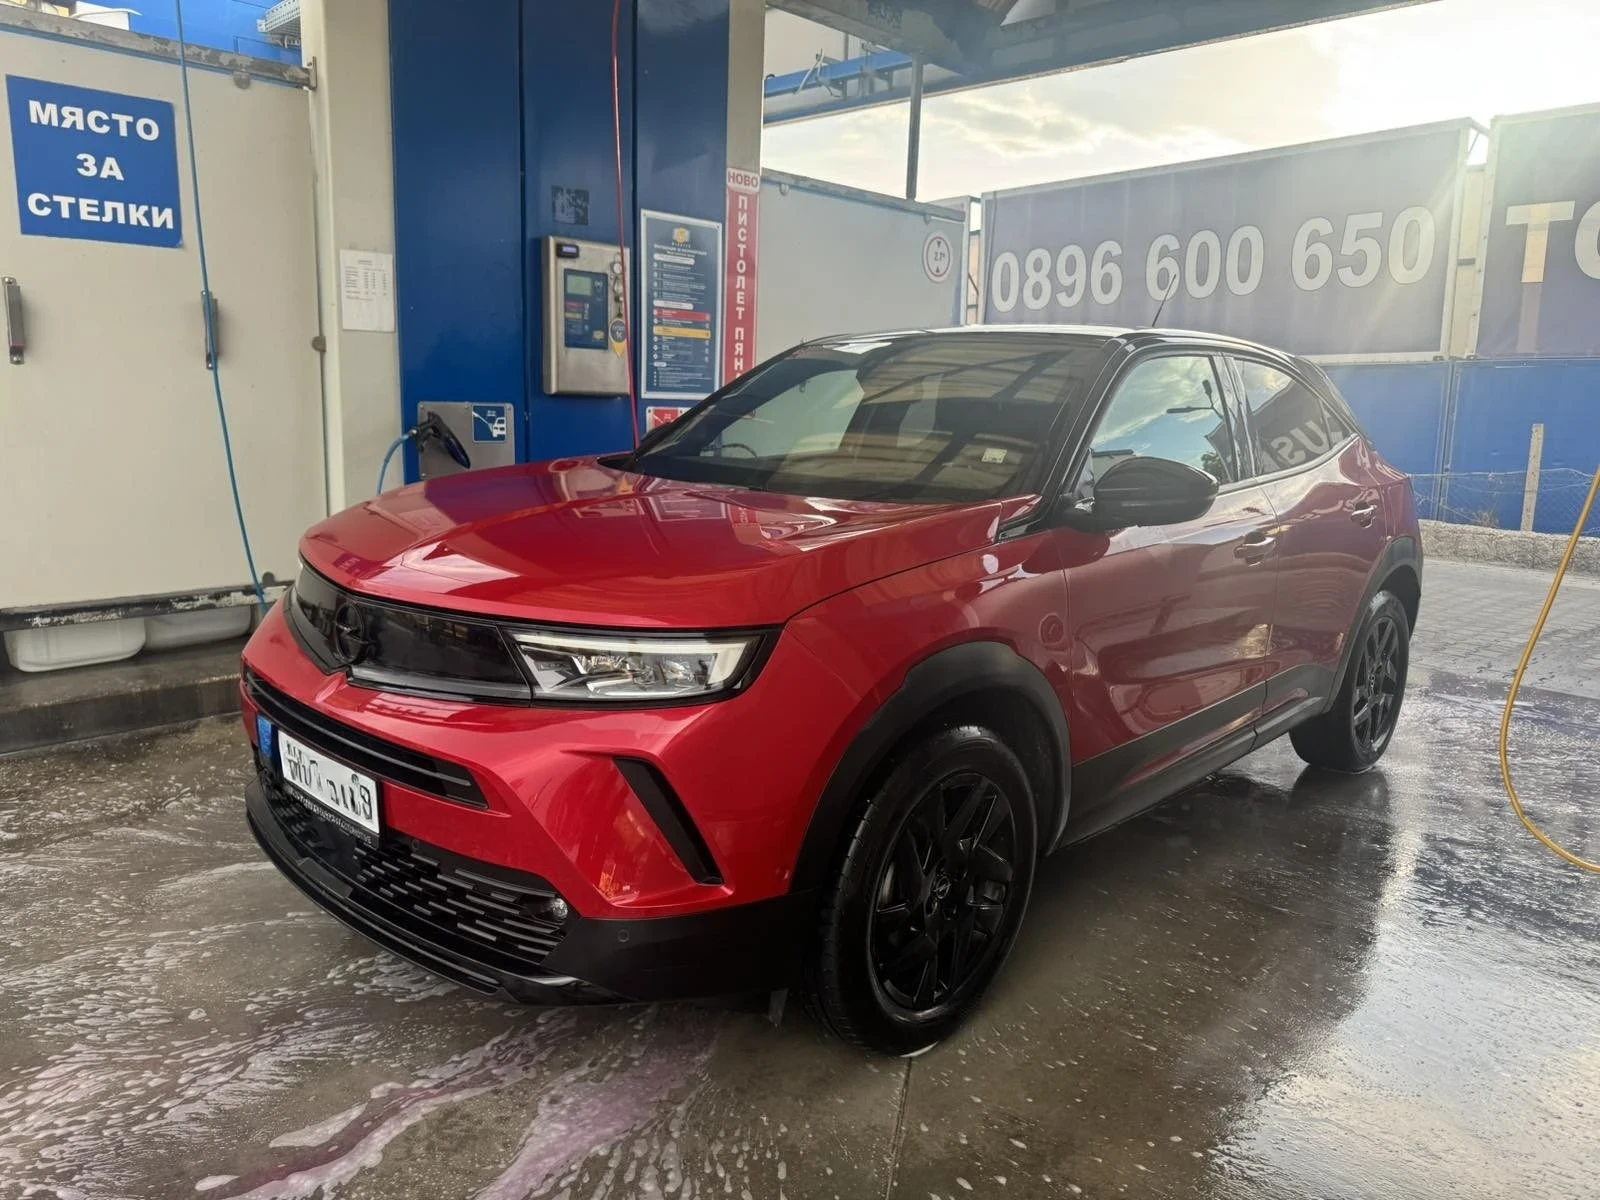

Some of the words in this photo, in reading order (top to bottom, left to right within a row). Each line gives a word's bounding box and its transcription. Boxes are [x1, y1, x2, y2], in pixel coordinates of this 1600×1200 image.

[28, 100, 160, 141] МЯСТО
[76, 153, 125, 181] ЗА
[727, 171, 759, 189] НОВО
[27, 193, 174, 229] СТЕЛКИ
[735, 194, 749, 320] ПИСТОЛЕТ
[991, 240, 1123, 312] 0896
[1145, 225, 1264, 301] 600
[1291, 205, 1435, 291] 650
